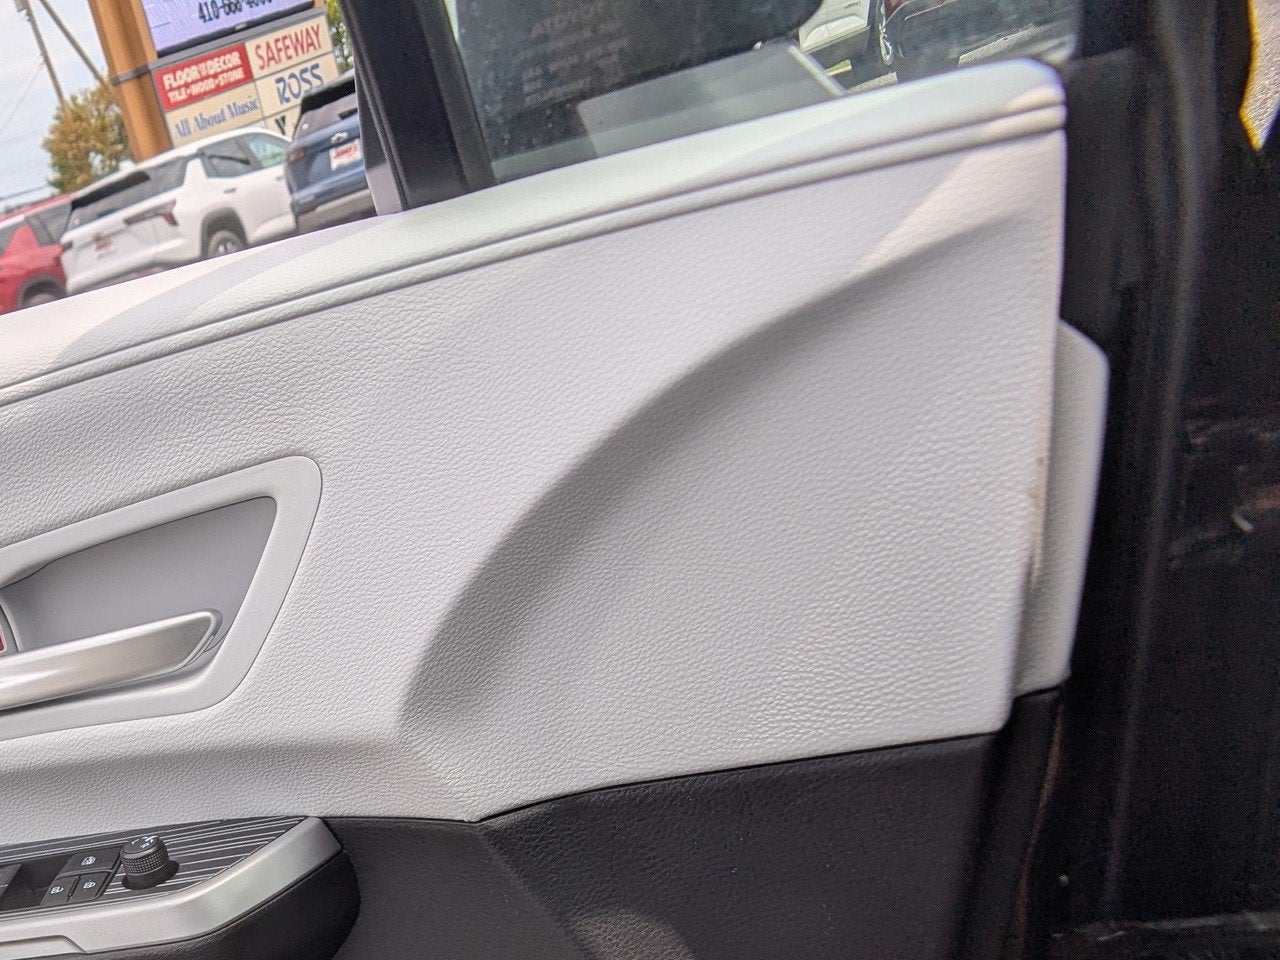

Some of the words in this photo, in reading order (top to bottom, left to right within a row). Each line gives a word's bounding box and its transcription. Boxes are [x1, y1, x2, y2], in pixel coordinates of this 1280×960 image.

[206, 51, 243, 76] DECOR
[254, 23, 323, 71] SAFEWAY
[274, 62, 324, 105] ROSS
